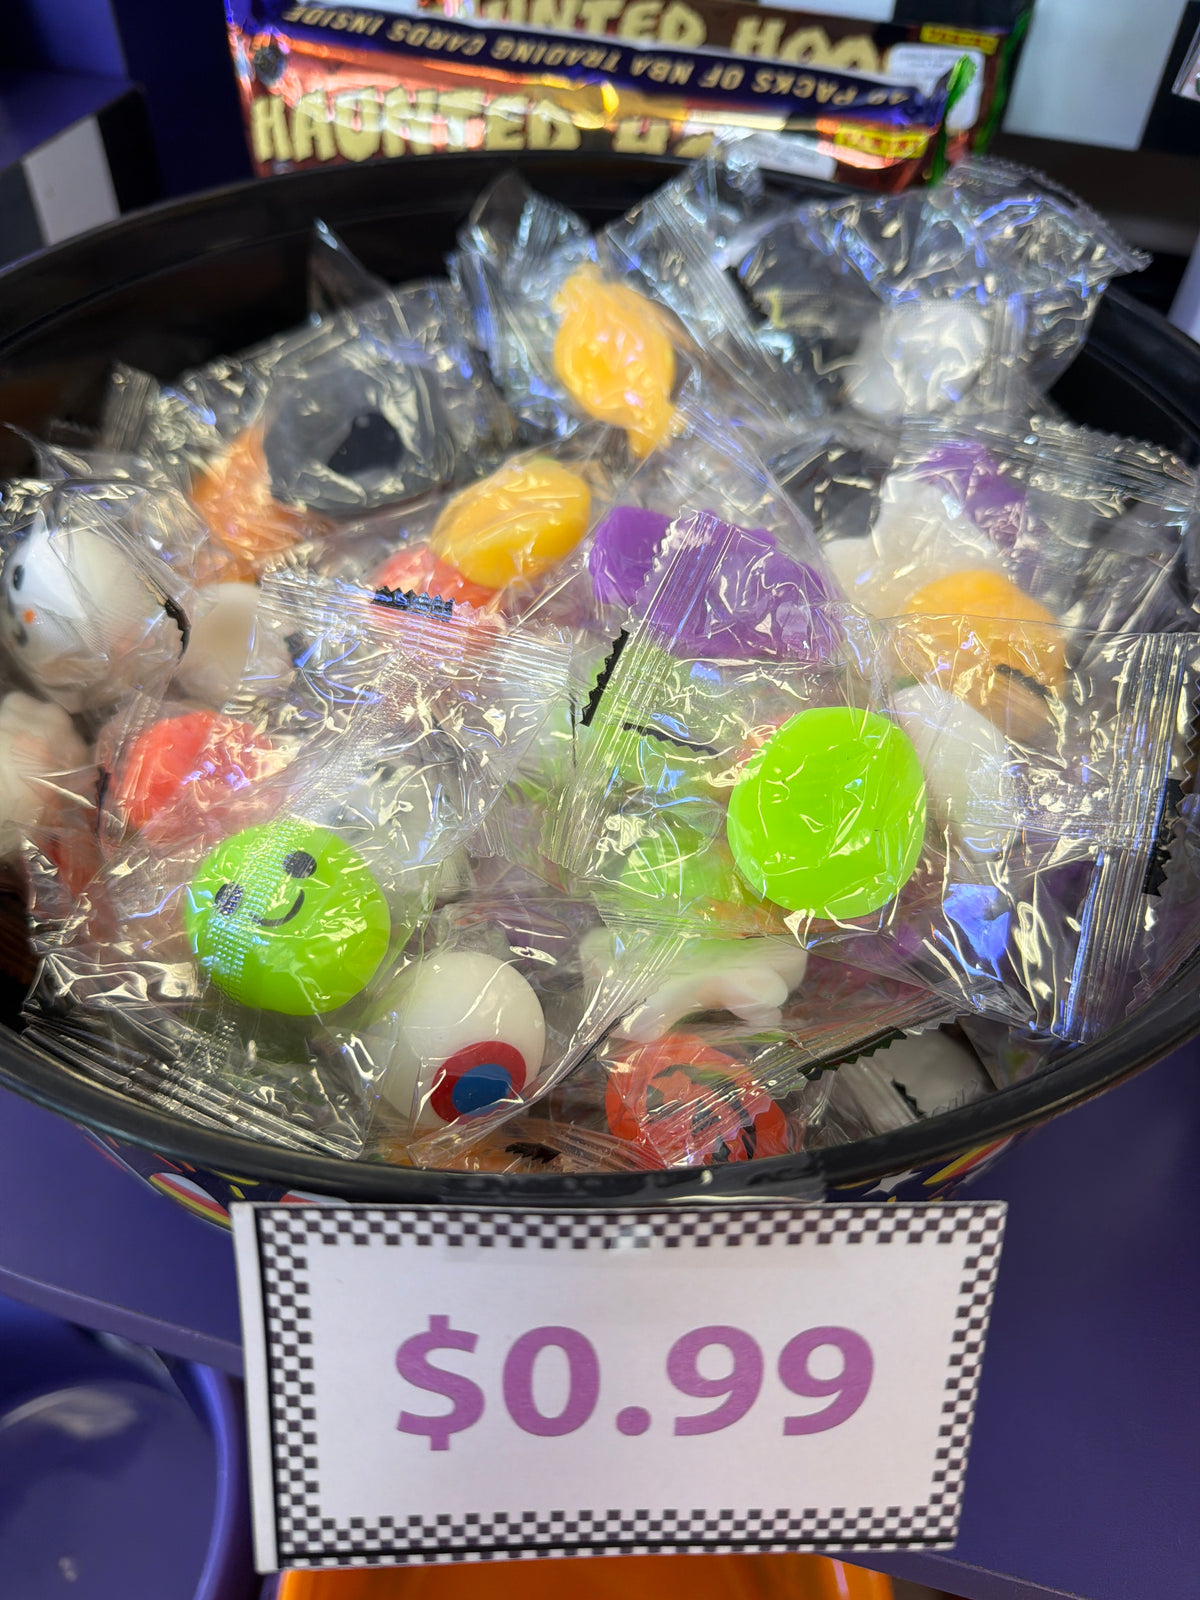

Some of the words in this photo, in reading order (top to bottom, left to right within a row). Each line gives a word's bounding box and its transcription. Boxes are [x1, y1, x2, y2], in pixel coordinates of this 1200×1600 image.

[281, 6, 385, 37] INSIDE
[385, 23, 488, 57] CARDS
[489, 37, 623, 76] TRADING
[731, 15, 889, 74] HOO
[630, 55, 695, 85] NBA
[699, 63, 745, 91] OF
[752, 67, 858, 106] PACKS
[252, 86, 581, 162] HAUNTED
[395, 1315, 874, 1450] $0.99
